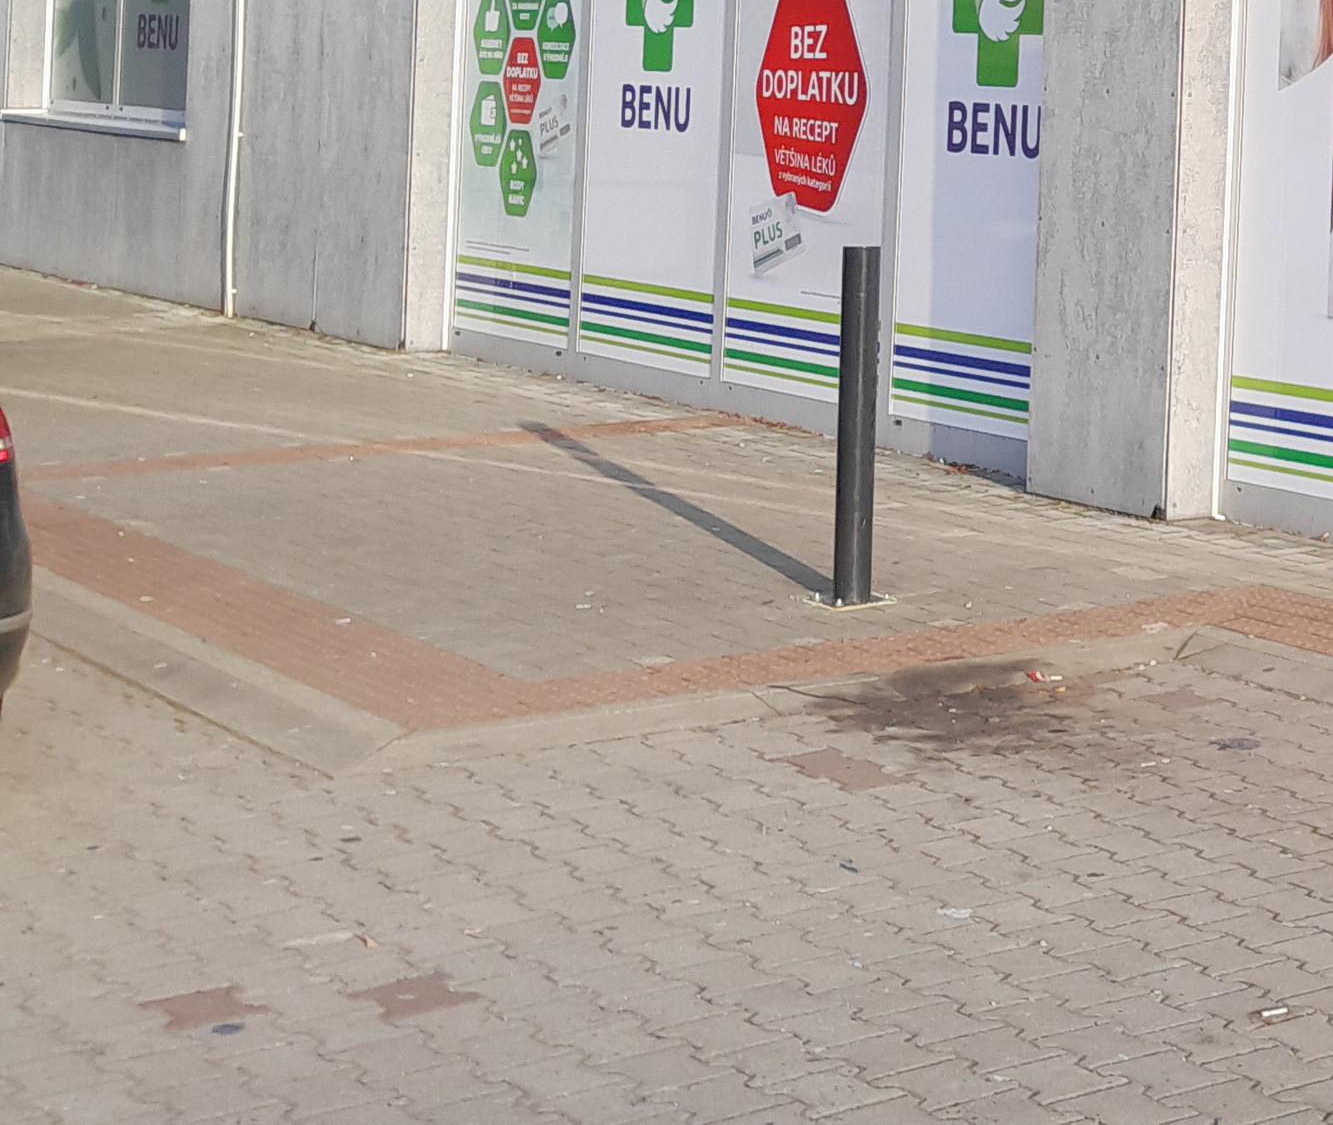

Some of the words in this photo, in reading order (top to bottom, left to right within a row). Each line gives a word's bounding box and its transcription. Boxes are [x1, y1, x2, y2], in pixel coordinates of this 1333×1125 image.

[137, 13, 180, 51] BENU
[790, 24, 827, 59] BEZ
[762, 69, 858, 105] DOPLATKU
[620, 84, 691, 132] BENU
[540, 116, 559, 136] PLUS
[774, 115, 790, 136] NA
[793, 118, 838, 144] RECEPT
[947, 101, 1041, 159] BENU
[774, 145, 810, 170] VĚTŠINA
[812, 152, 836, 176] LÉKŮ
[753, 221, 783, 250] PLUS
